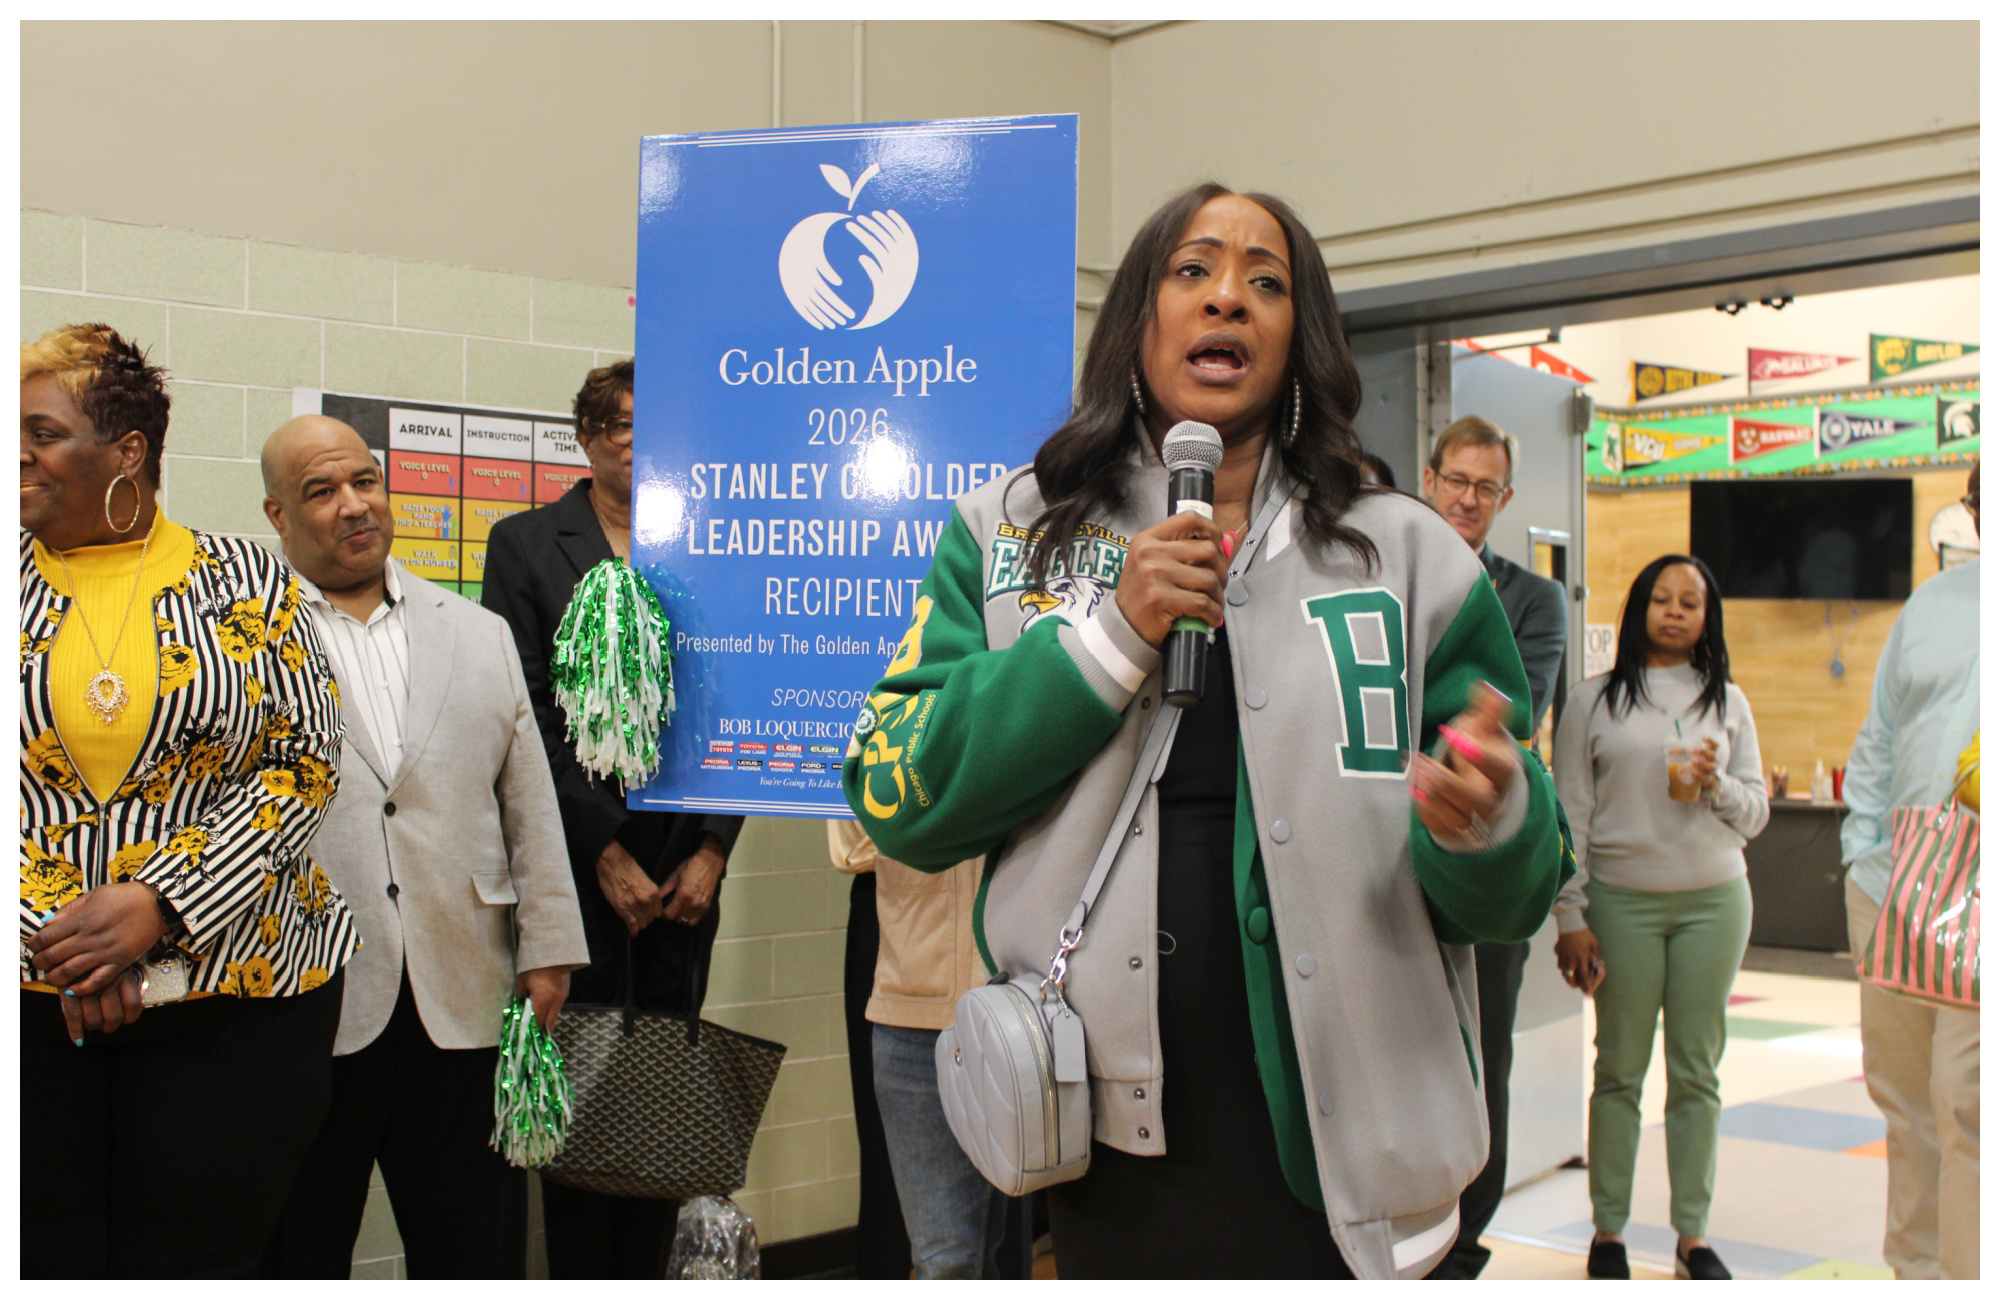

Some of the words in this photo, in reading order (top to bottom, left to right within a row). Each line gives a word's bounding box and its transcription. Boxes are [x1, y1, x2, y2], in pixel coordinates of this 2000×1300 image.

[719, 347, 857, 385] Golden
[864, 344, 977, 397] Apple
[400, 423, 453, 438] ARRIVAL
[808, 408, 889, 445] 2026
[1850, 420, 1896, 437] YALE
[467, 429, 530, 443] INSTRUCTION
[543, 430, 577, 442] ACTIVI
[555, 443, 578, 453] TIME
[1633, 433, 1667, 461] VCU
[400, 461, 425, 471] VOICE
[427, 464, 450, 473] LEVEL
[472, 468, 498, 478] VOICE
[499, 471, 521, 480] LEVEL
[544, 473, 569, 483] VOICE
[690, 463, 828, 500] STANLEY
[425, 505, 445, 513] YOUR
[476, 509, 497, 517] RAISE
[395, 519, 412, 527] FIND
[421, 520, 452, 529] TEACHER
[688, 519, 881, 557] LEADERSHIP
[414, 550, 437, 558] WALK
[424, 559, 457, 568] NUMBER
[765, 577, 923, 617] RECIPIENT
[677, 631, 752, 653] Presented
[759, 633, 774, 655] by
[780, 634, 808, 654] The
[816, 634, 870, 654] Golden
[1300, 586, 1412, 780] B
[914, 693, 937, 729] Schools
[719, 718, 751, 735] BOB
[756, 719, 856, 740] LOQUERCIO
[906, 732, 921, 764] Public
[760, 777, 782, 786] You're
[783, 778, 806, 789] Going
[808, 778, 817, 788] To
[818, 779, 836, 789] Like
[908, 767, 930, 808] Chicago
